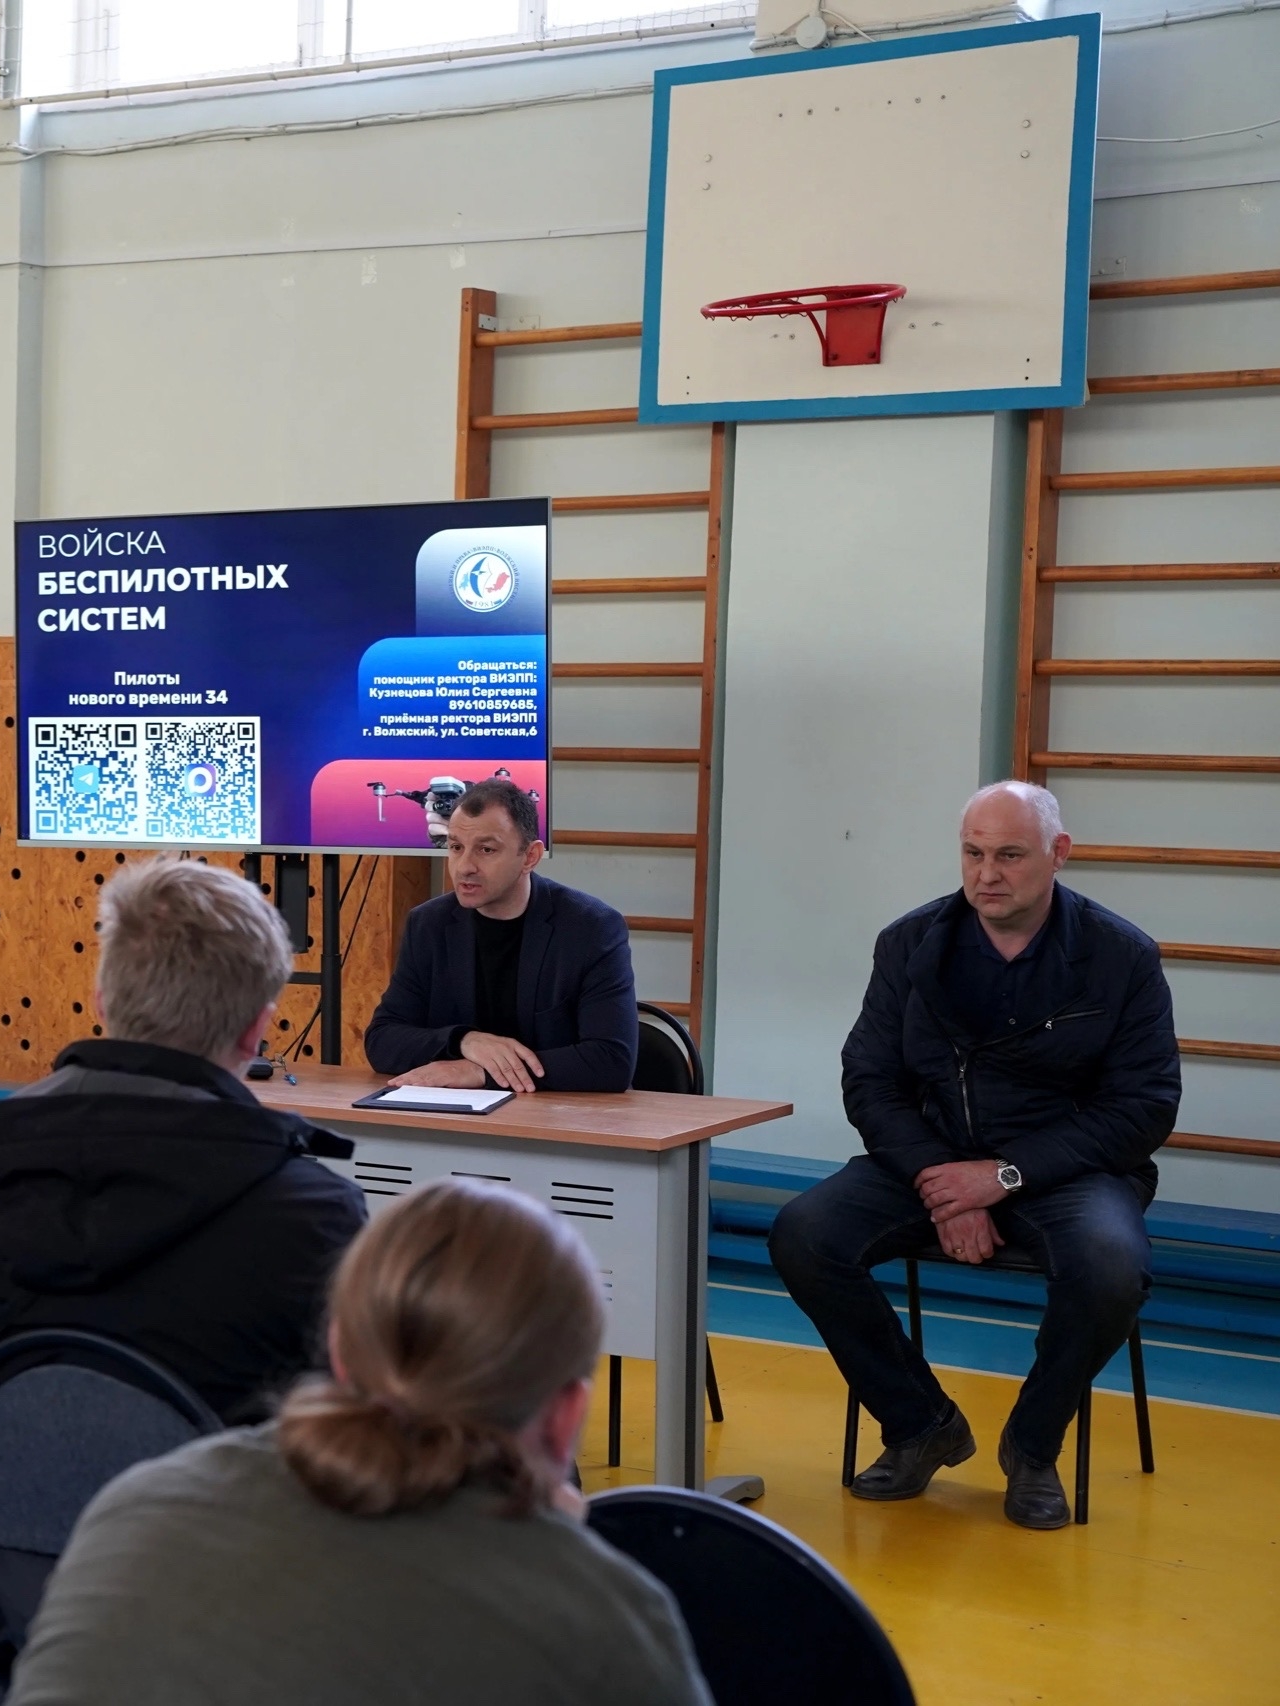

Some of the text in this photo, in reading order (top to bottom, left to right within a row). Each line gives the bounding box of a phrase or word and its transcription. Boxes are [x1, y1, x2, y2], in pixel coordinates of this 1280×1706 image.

[38, 527, 167, 559] ВОЙСКА
[37, 564, 290, 596] БЕСПИЛОТНЫХ
[36, 605, 167, 633] СИСТЕМ
[457, 660, 538, 672] Обращаться:
[113, 671, 181, 686] Пилоты
[373, 672, 538, 686] помощник ректора ВИЭПП:
[68, 690, 229, 708] нового времени 34
[369, 686, 538, 700] Кузнецова Юлия Сергеевна
[448, 699, 538, 711] 89610859685,
[380, 712, 538, 726] приёмная ректора ВИЭПП
[362, 726, 538, 738] г. Волжский, ул. Советская,6
